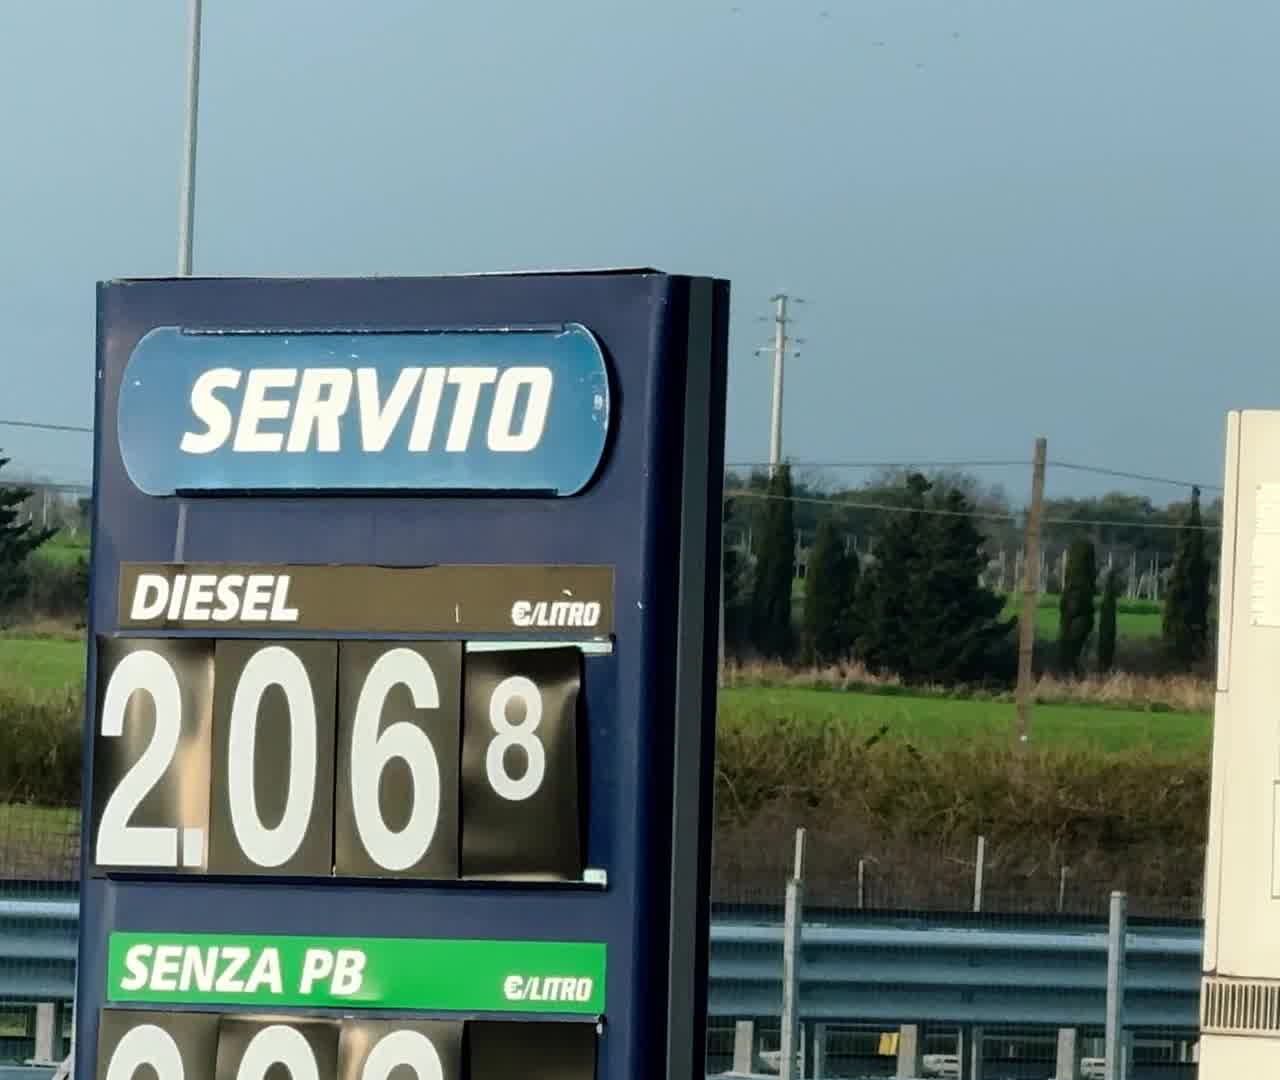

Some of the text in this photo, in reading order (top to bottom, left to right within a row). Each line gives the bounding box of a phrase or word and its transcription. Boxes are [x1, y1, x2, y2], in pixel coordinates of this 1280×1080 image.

[179, 366, 553, 454] SERVITO
[130, 574, 601, 627] DIESEL €/LITRO
[120, 945, 592, 1002] SENZA PB €/LITRO
